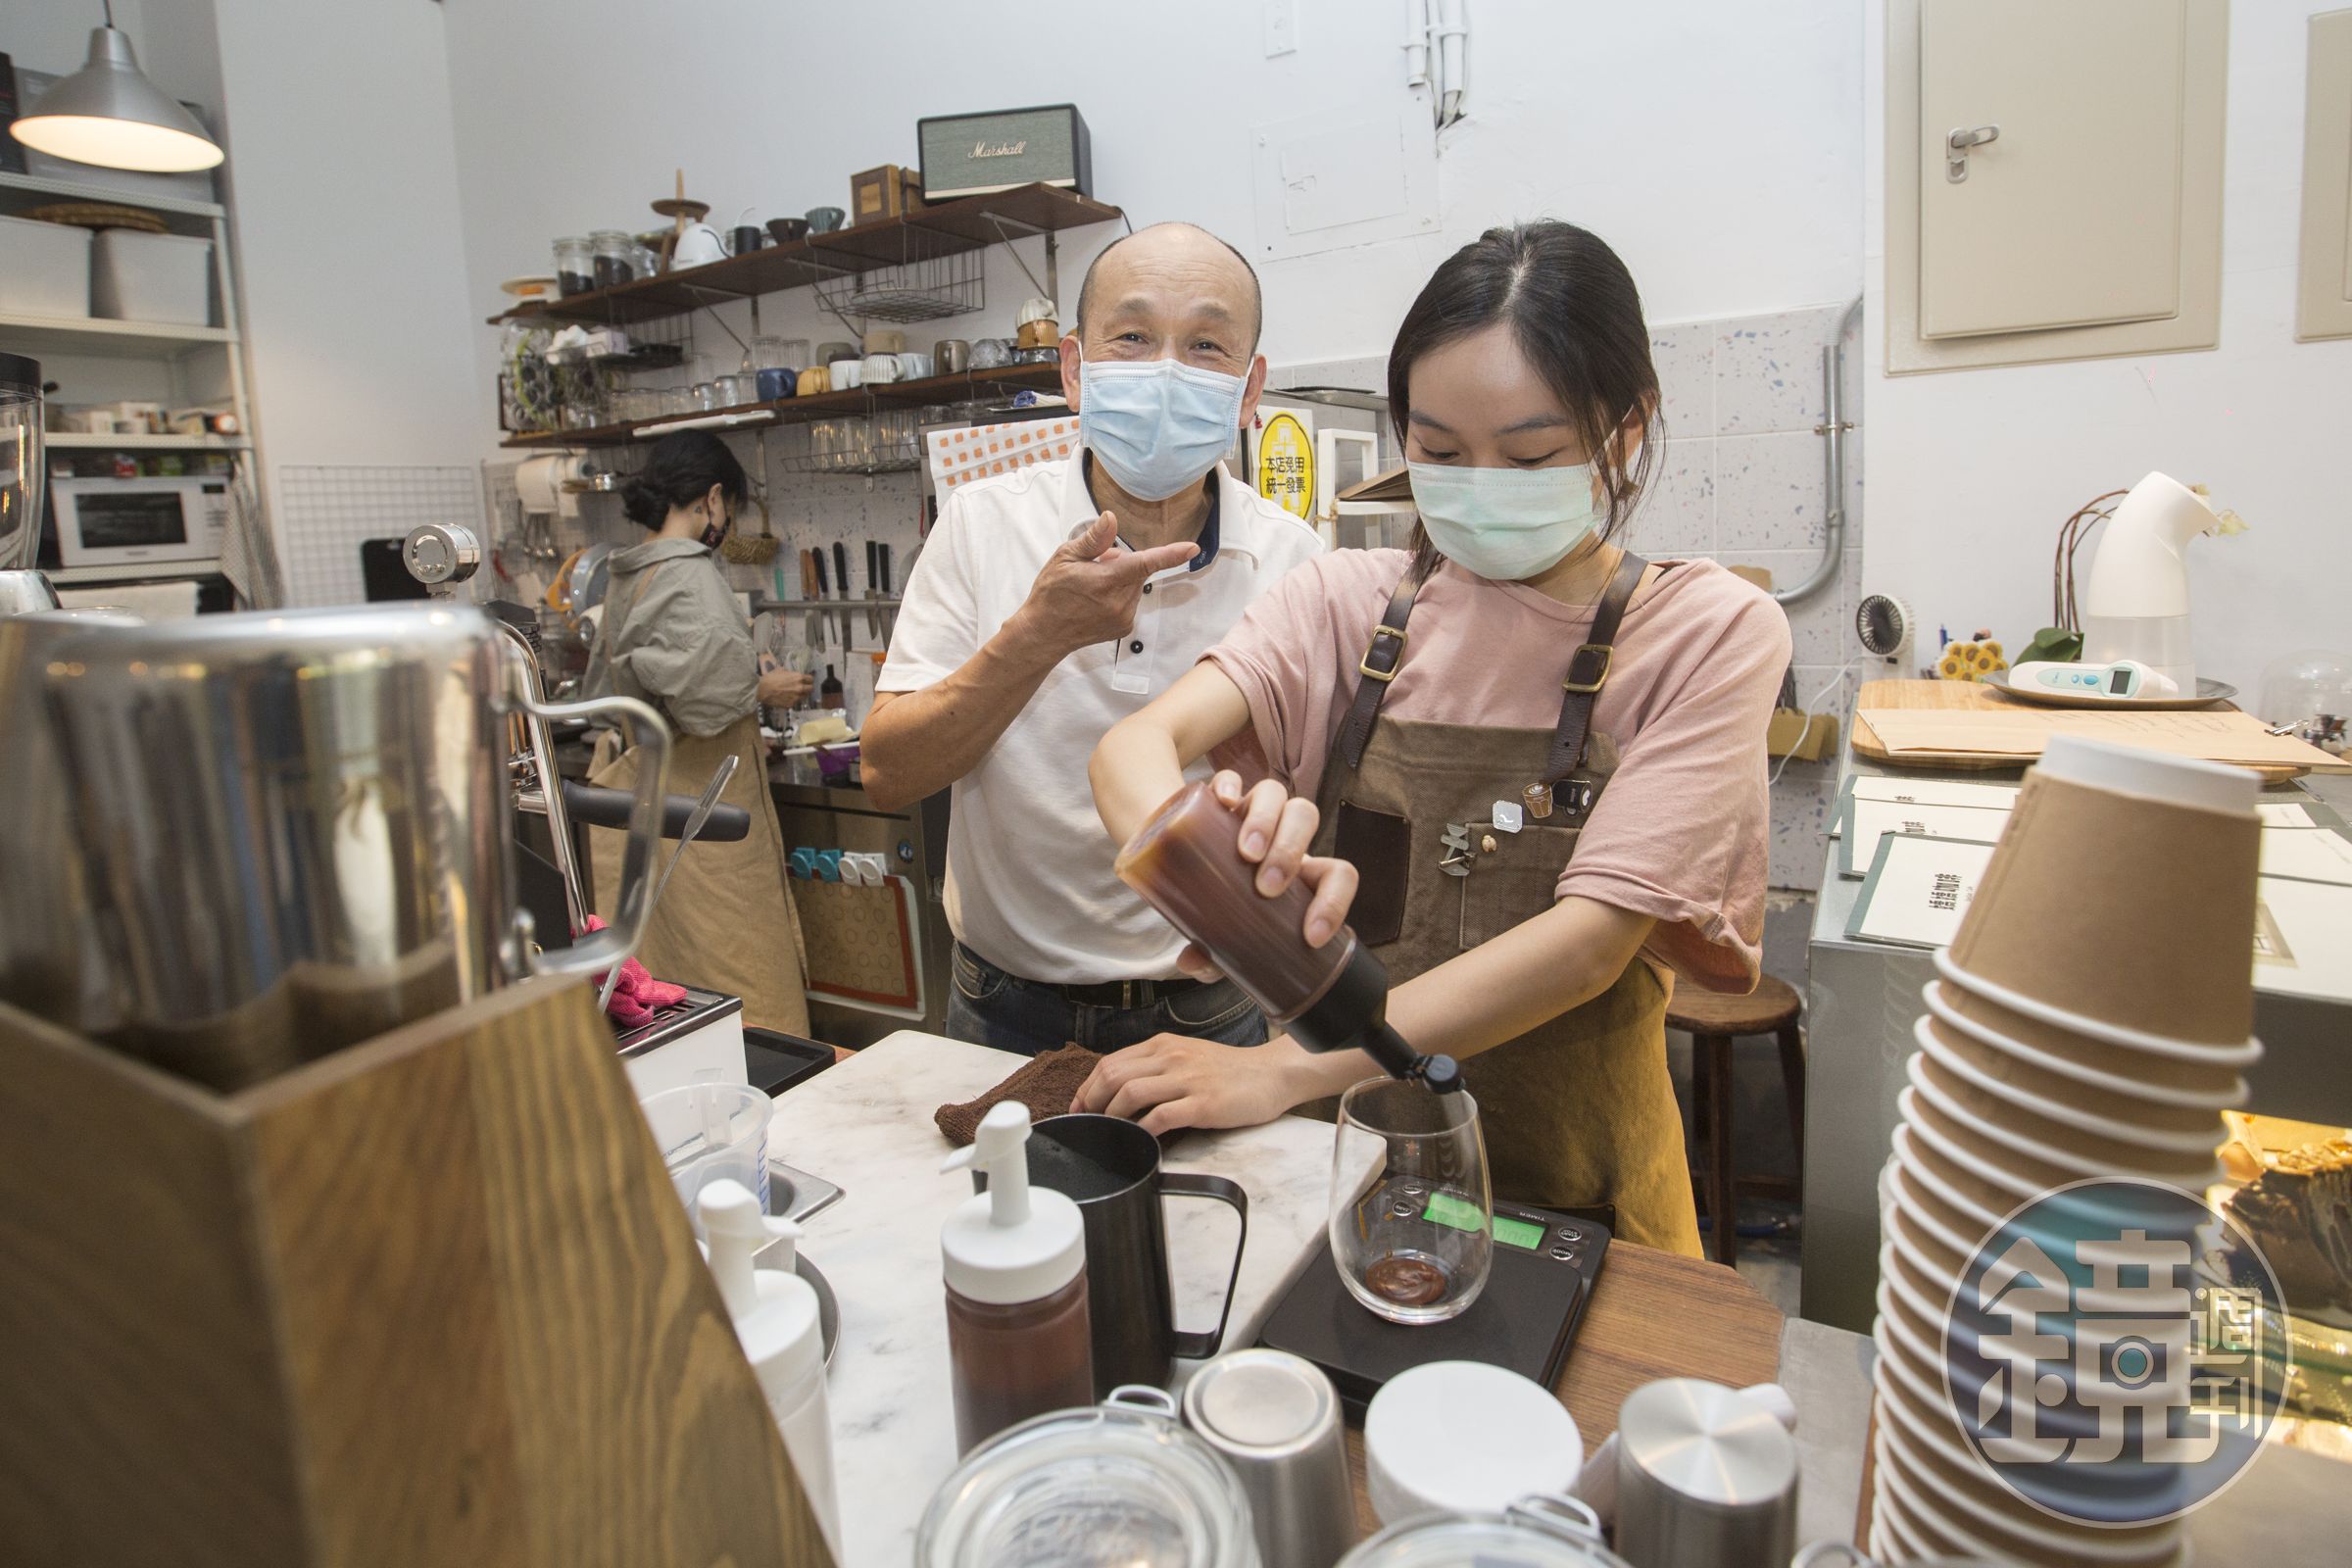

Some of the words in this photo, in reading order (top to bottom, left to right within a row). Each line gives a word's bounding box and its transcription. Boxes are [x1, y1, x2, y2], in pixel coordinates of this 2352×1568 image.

[968, 141, 1026, 158] Marshall
[1265, 456, 1304, 473] 本店免用
[1266, 476, 1305, 494] 統一發票
[1519, 1212, 1545, 1222] TIMER
